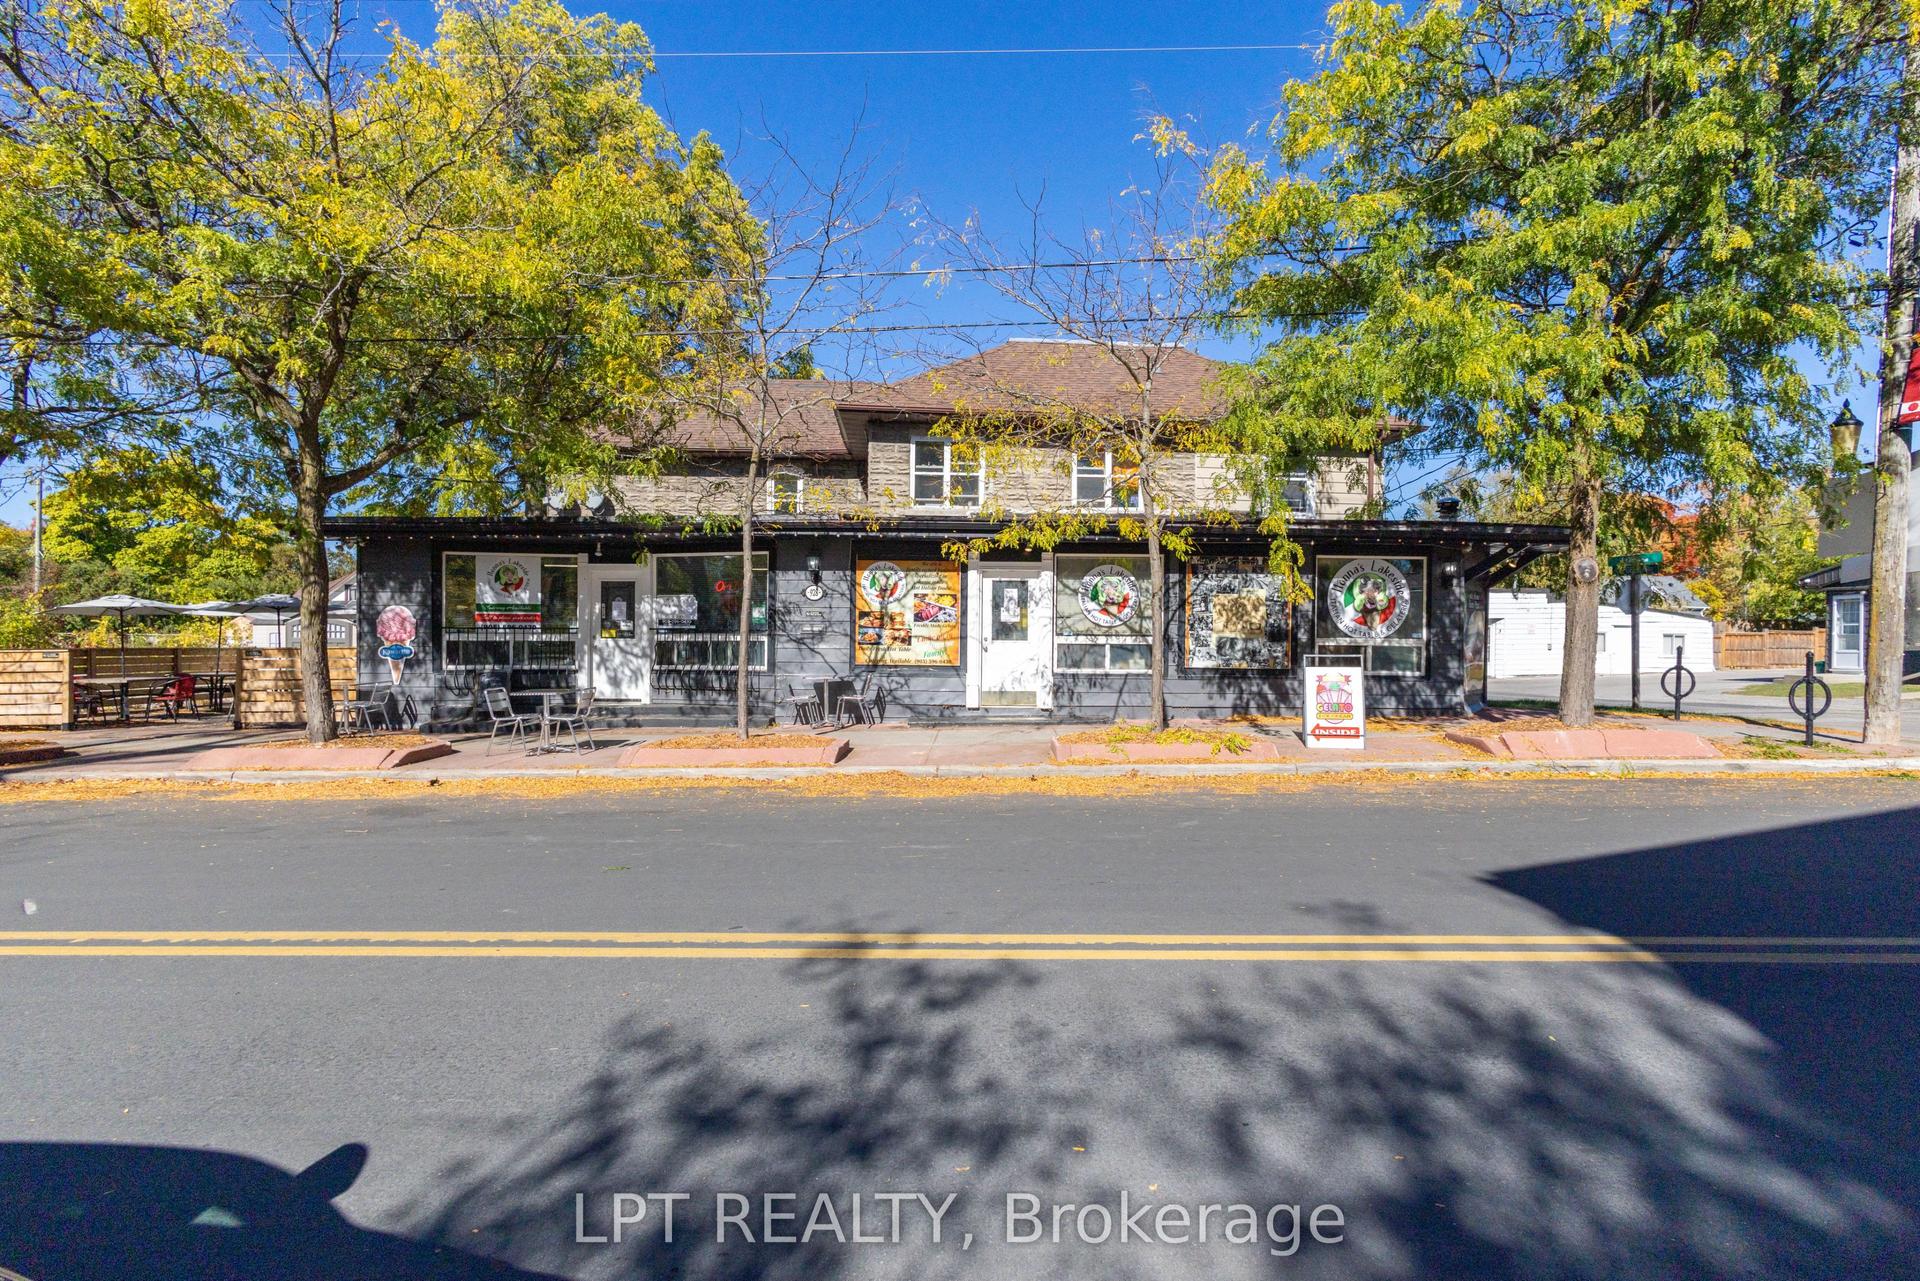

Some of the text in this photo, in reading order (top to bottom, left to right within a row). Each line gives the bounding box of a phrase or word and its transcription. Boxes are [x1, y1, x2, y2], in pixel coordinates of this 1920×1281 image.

[1110, 565, 1136, 591] Lakeside
[1331, 559, 1406, 595] Nonna's Lakeside
[1330, 598, 1344, 624] ITALIAN
[1343, 623, 1358, 634] HOT
[1359, 630, 1378, 638] TAB
[1316, 702, 1353, 713] GELATO
